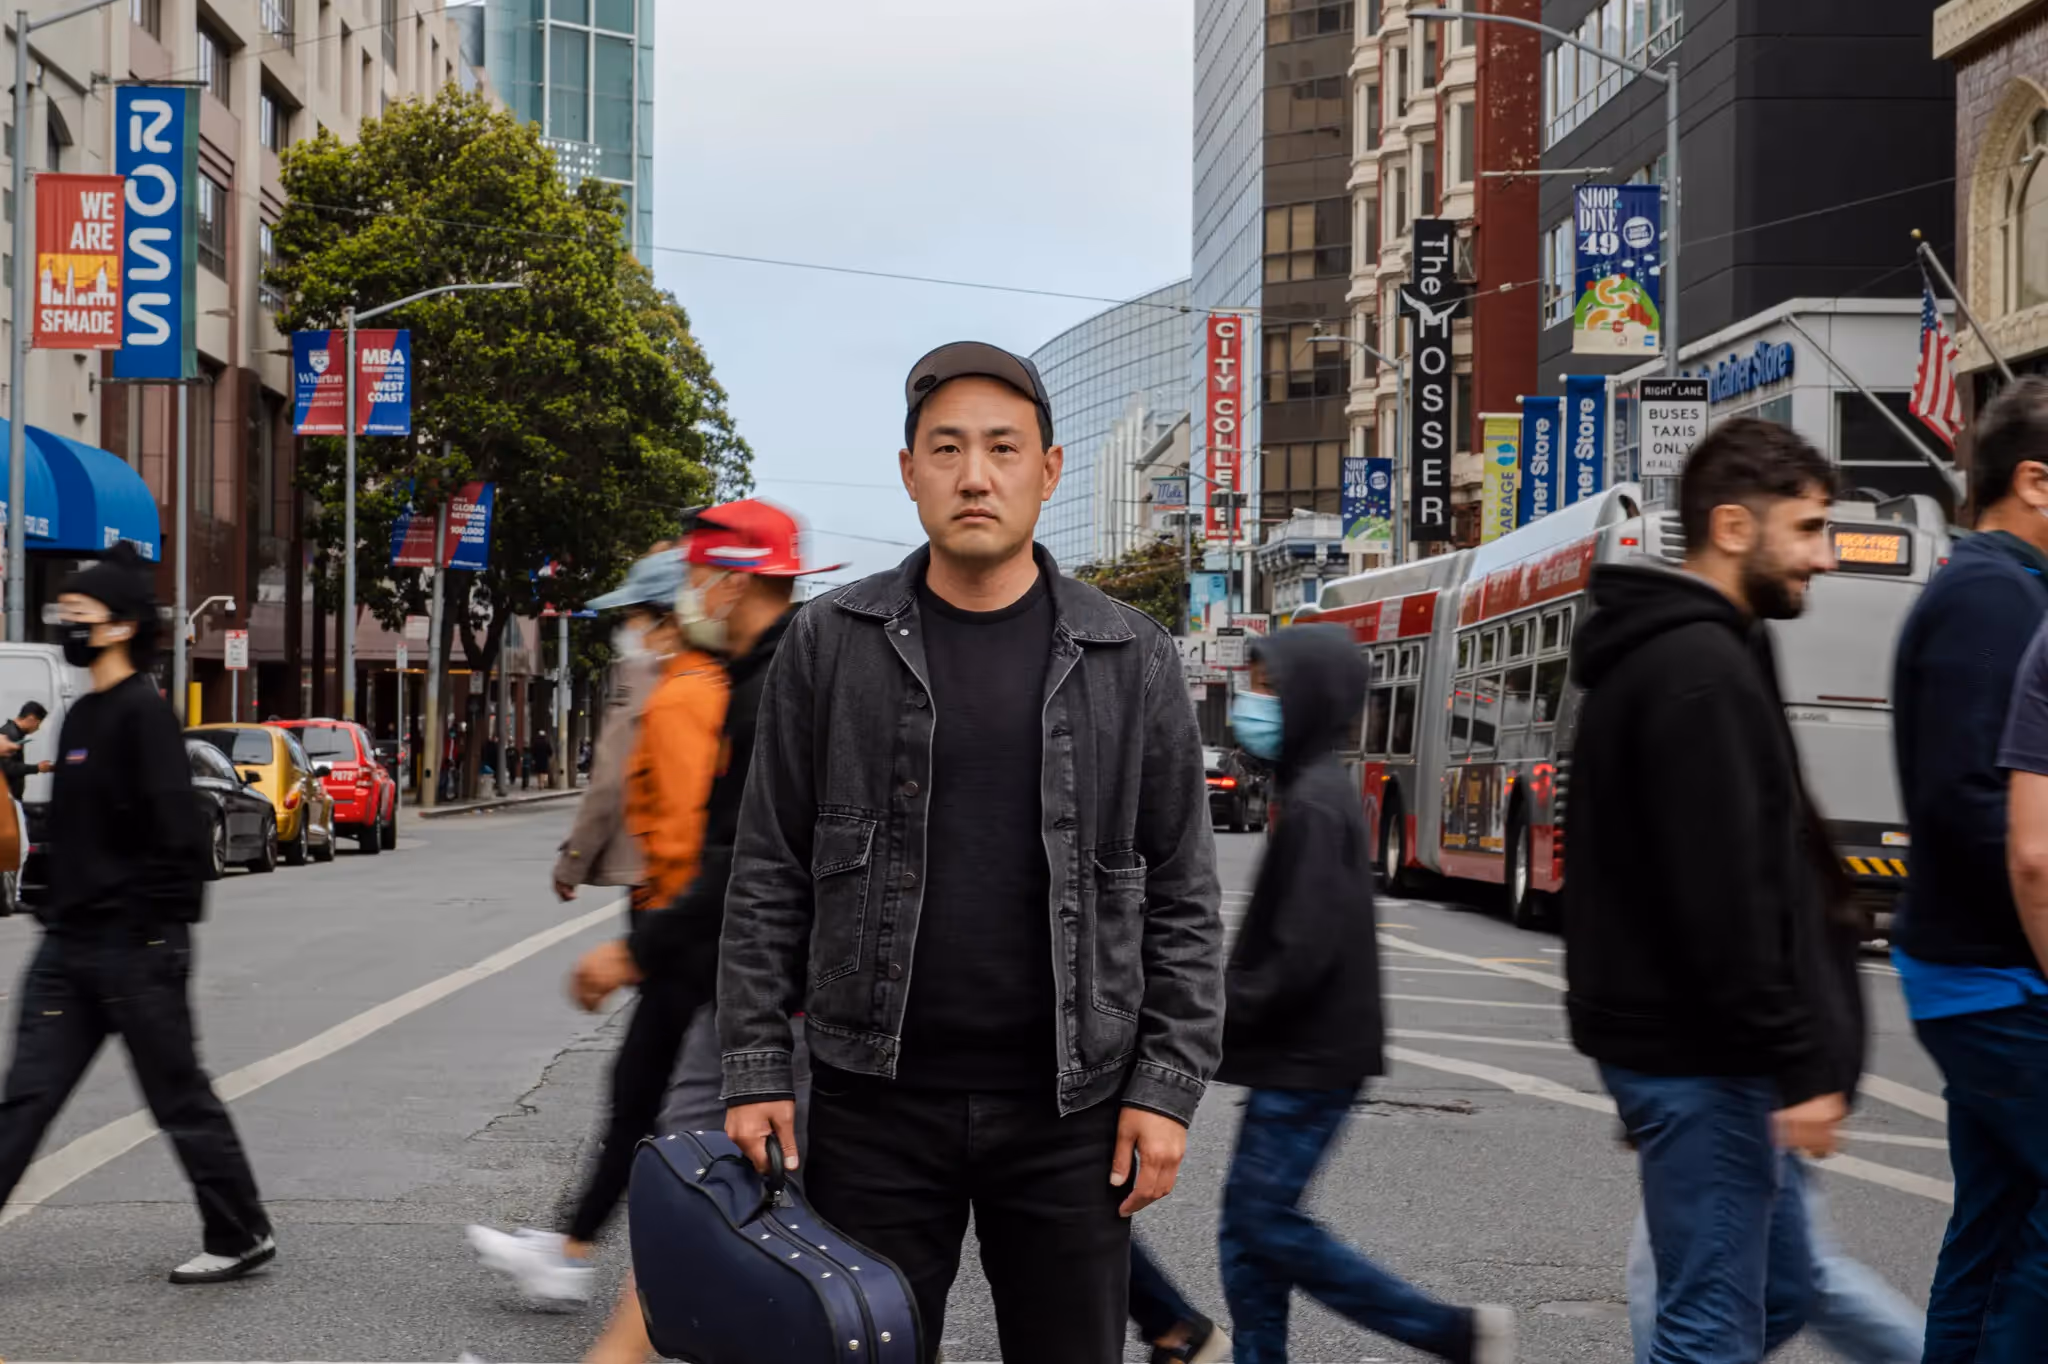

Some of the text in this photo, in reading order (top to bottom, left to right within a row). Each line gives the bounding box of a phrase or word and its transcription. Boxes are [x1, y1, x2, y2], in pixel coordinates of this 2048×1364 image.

[80, 191, 115, 220] WE
[1579, 188, 1618, 209] SHOP
[125, 99, 176, 345] ROSS
[1579, 209, 1618, 231] DINE
[70, 222, 114, 250] ARE
[1579, 232, 1619, 256] 49
[1420, 234, 1448, 295] The
[41, 309, 114, 334] SFMADE
[362, 348, 405, 365] MBA
[1213, 322, 1236, 392] CITY
[1755, 341, 1794, 384] Store
[298, 372, 343, 384] Wharton
[373, 381, 404, 392] WEST
[367, 392, 404, 403] COAST
[1645, 386, 1704, 396] RIGHT LANE
[1410, 294, 1455, 525] MOSSER
[1649, 408, 1699, 420] BUSES
[1574, 397, 1596, 460] Store
[1652, 425, 1696, 437] TAXIS
[1530, 418, 1551, 477] Store
[1653, 443, 1694, 455] ONLY
[1212, 399, 1236, 522] COLLEE
[452, 503, 486, 513] GLOBAL
